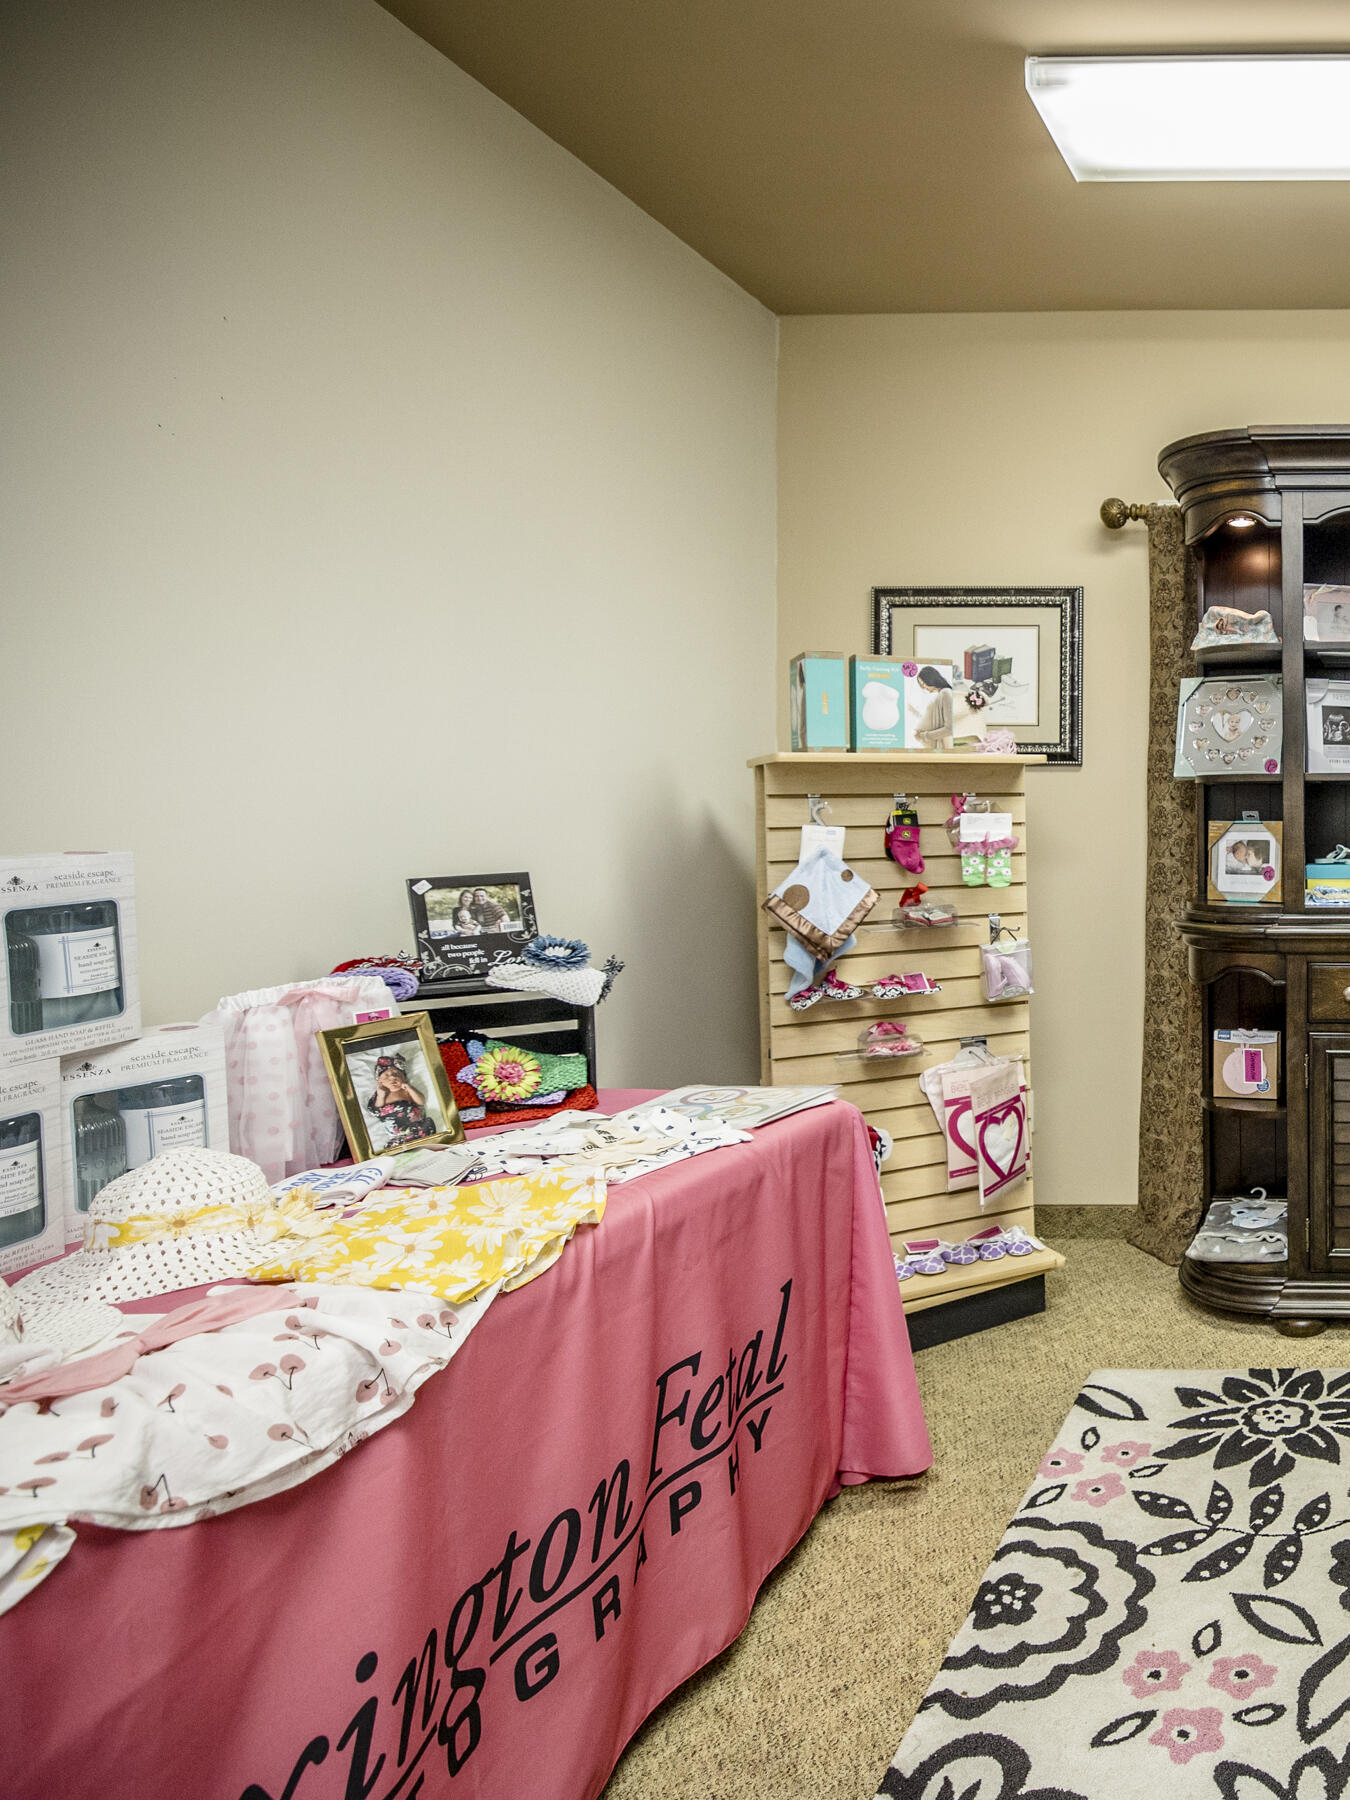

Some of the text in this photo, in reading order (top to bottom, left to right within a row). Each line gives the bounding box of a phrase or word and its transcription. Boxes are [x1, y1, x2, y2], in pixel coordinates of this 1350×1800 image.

[54, 870, 114, 880] seaside escape
[0, 884, 38, 894] SSENZA
[46, 877, 121, 889] PREMIUM FRAGRANCE
[488, 950, 524, 966] Lov
[130, 1046, 200, 1062] seaside escape
[120, 1052, 209, 1072] PREMIUM FRAGRANCE
[62, 1068, 112, 1081] ESSENZA
[10, 1080, 38, 1092] escape
[646, 1278, 794, 1493] Fetal
